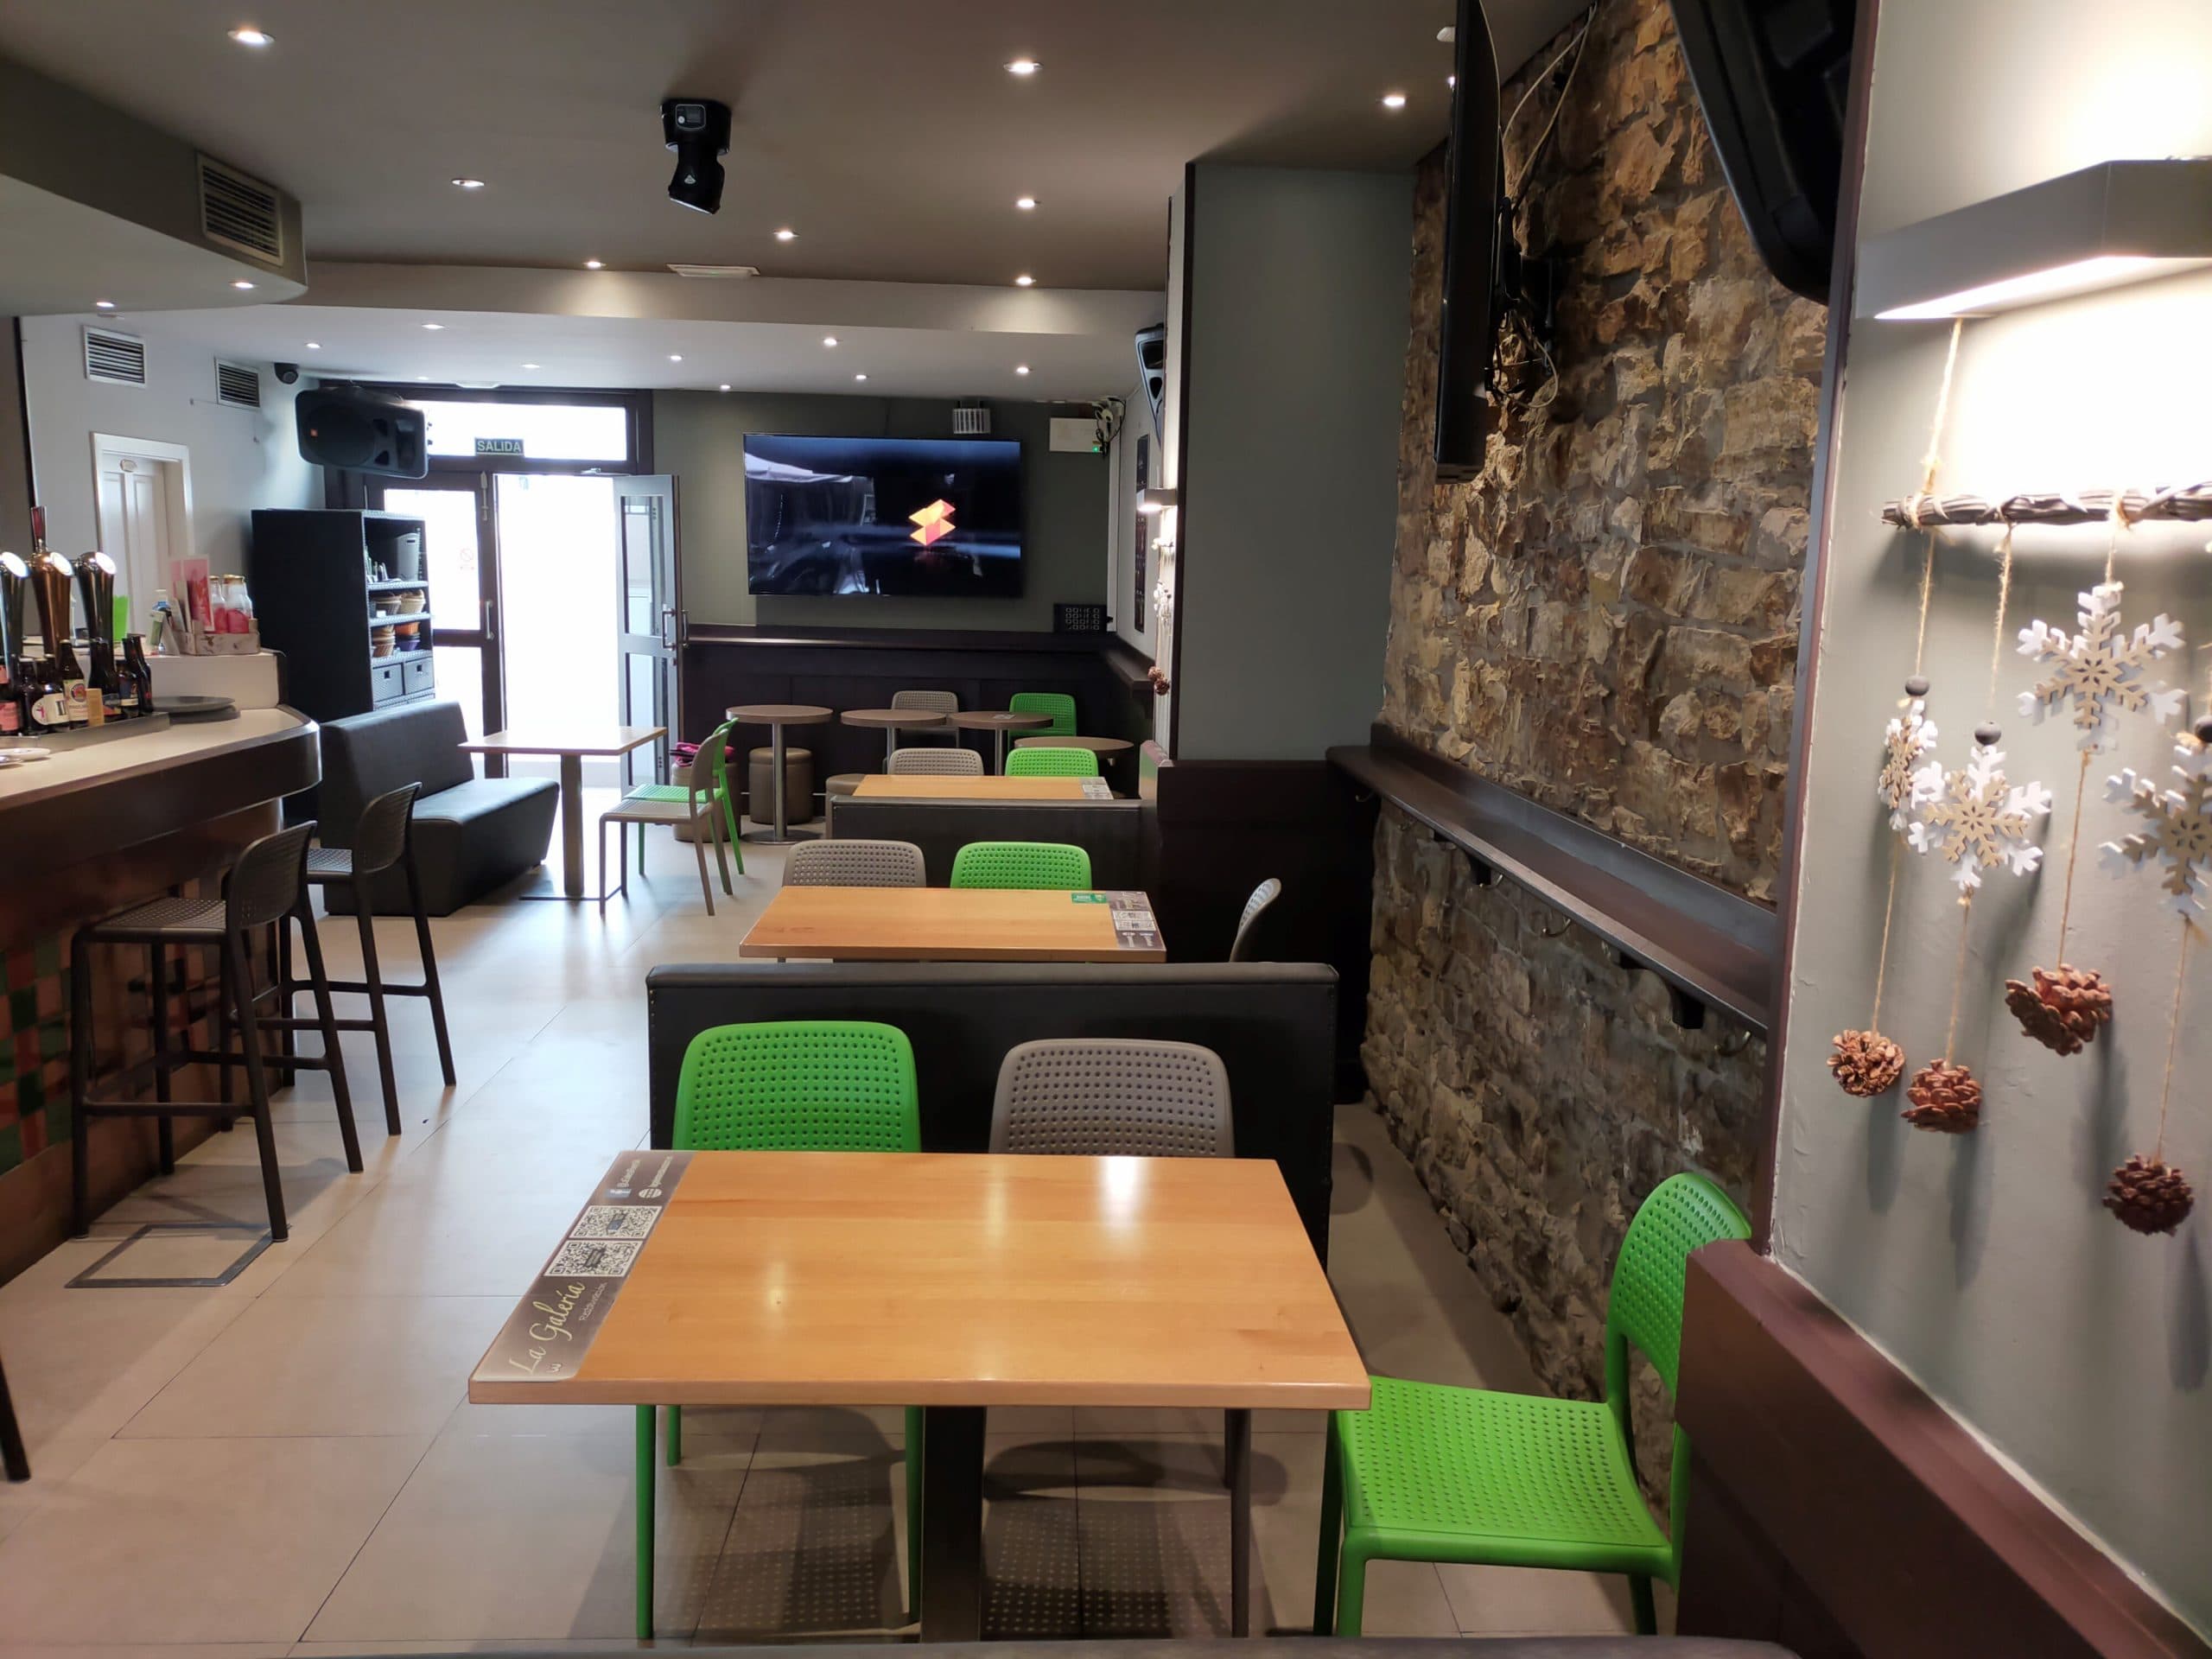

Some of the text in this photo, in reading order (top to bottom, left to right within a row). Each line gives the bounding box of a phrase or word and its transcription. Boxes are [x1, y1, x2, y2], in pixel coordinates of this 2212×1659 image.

[477, 440, 522, 453] SALIDA
[509, 1281, 586, 1376] La Galería
